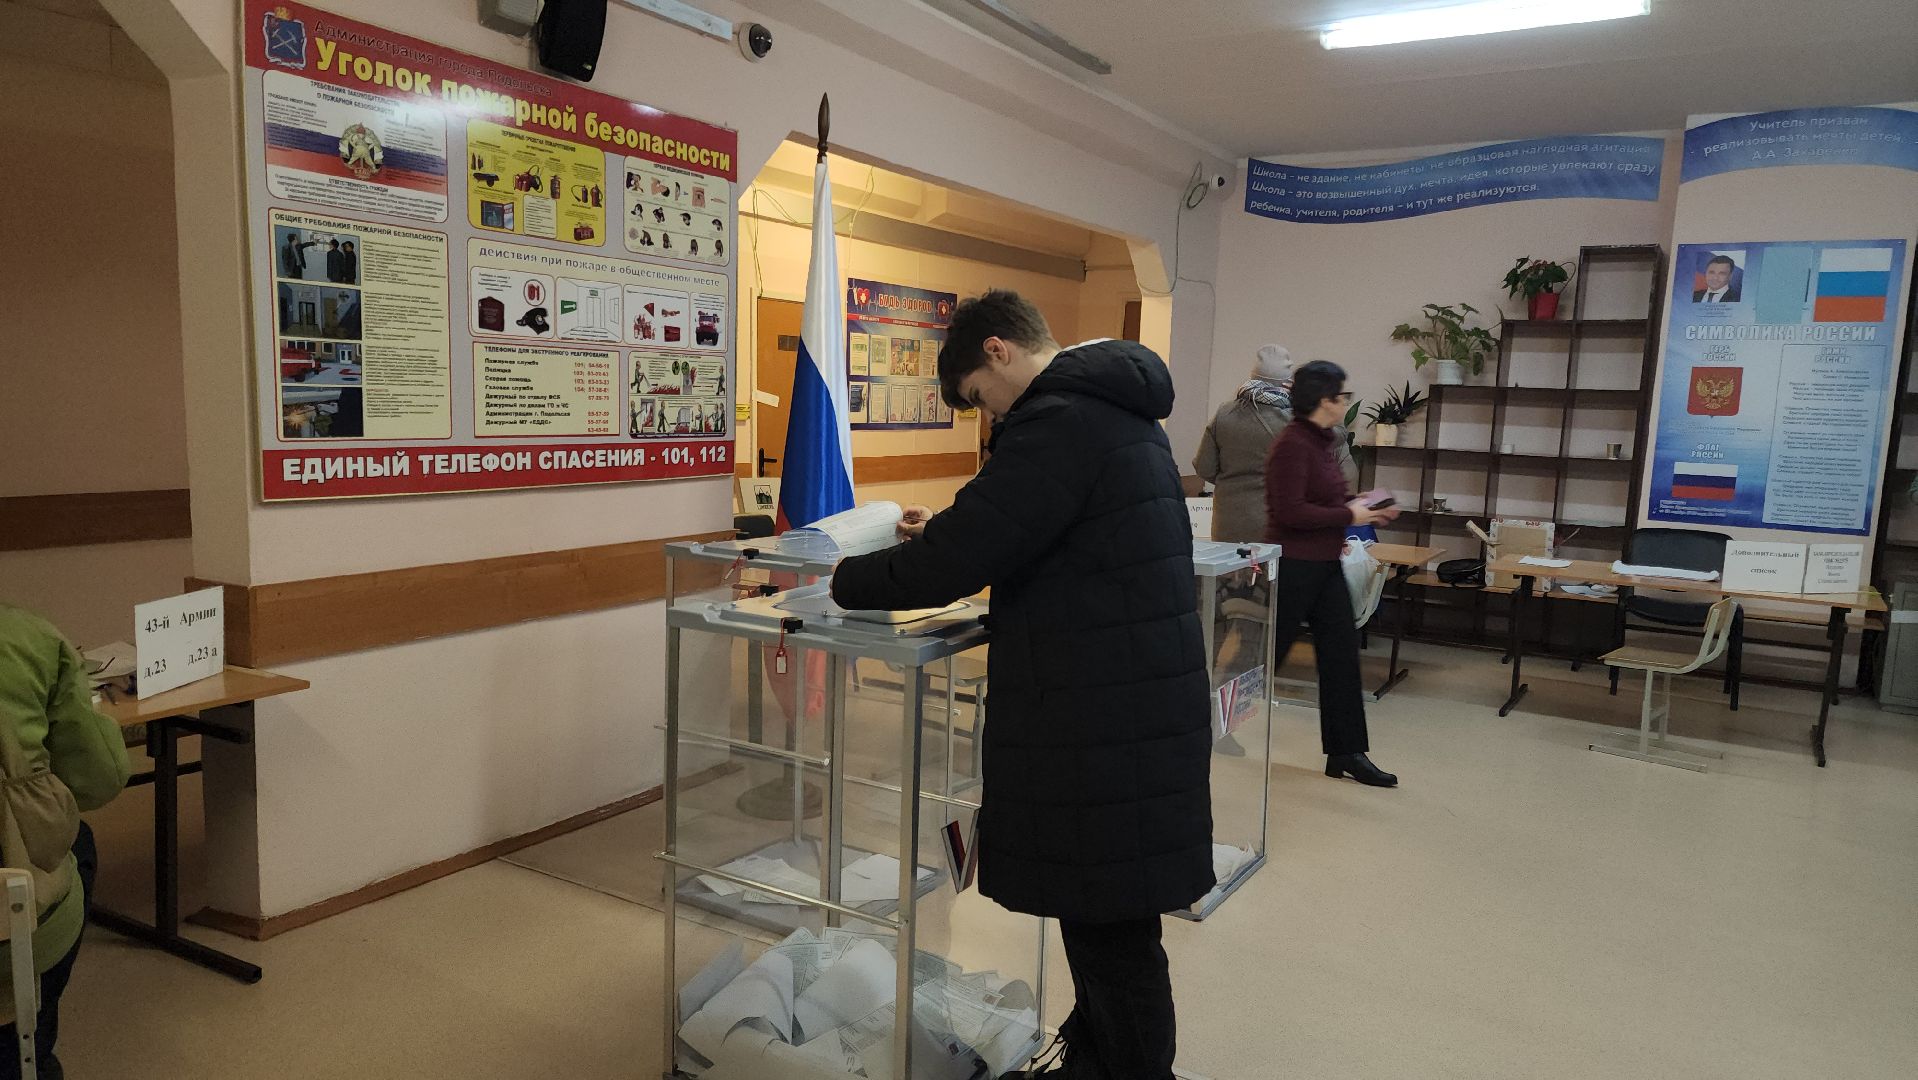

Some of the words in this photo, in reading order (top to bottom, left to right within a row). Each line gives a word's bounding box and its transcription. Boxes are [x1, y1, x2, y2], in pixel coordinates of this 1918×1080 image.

[314, 20, 434, 65] Администрация
[438, 56, 485, 79] города
[487, 67, 552, 96] Подольска
[315, 36, 433, 97] Уголок
[441, 79, 577, 134] пожарной
[584, 111, 730, 172] безопасности
[1750, 119, 1806, 132] Учитель
[1810, 117, 1869, 129] призван
[1703, 134, 1808, 157] реализовывать
[1813, 132, 1857, 141] мечты
[1252, 164, 1286, 180] Школа
[1297, 175, 1310, 183] не
[1355, 173, 1368, 181] не
[1430, 161, 1444, 170] не
[1448, 150, 1519, 166] образцовая
[1522, 143, 1588, 155] наглядная
[1591, 143, 1650, 154] агитация
[1251, 181, 1286, 196] Школа
[1295, 190, 1313, 199] это
[1315, 185, 1392, 199] возвышенный
[1495, 163, 1548, 176] которые
[1551, 162, 1613, 174] увлекают
[1617, 162, 1656, 176] сразу
[1249, 200, 1293, 216] ребенка,
[1296, 208, 1339, 219] учителя,
[1343, 204, 1394, 219] родителя
[1416, 198, 1434, 209] тут
[1437, 195, 1453, 204] же
[274, 213, 303, 224] ОБЩИЕ
[304, 217, 351, 230] ТРЕБОВАНИЯ
[352, 224, 392, 236] ПОЖАРНОЙ
[393, 230, 444, 243] БЕЗОПАСНОСТИ
[541, 256, 562, 266] при
[565, 259, 607, 272] пожаре
[619, 266, 691, 283] общественном
[694, 276, 720, 287] месте
[901, 297, 933, 314] ЗДОРОВ
[1685, 325, 1795, 341] СИМВОЛИКА
[1802, 325, 1876, 341] РОССИИ
[1702, 352, 1736, 361] РОССИИ
[282, 450, 410, 485] ЕДИНЫЙ
[418, 450, 532, 477] ТЕЛЕФОН
[540, 448, 646, 471] СПАСЕНИЯ
[660, 448, 695, 468] 101,
[699, 446, 727, 465] 112
[1690, 450, 1724, 459] РОССИИ
[144, 615, 170, 634] 43-й
[179, 607, 216, 626] Армии
[143, 657, 168, 679] д.23
